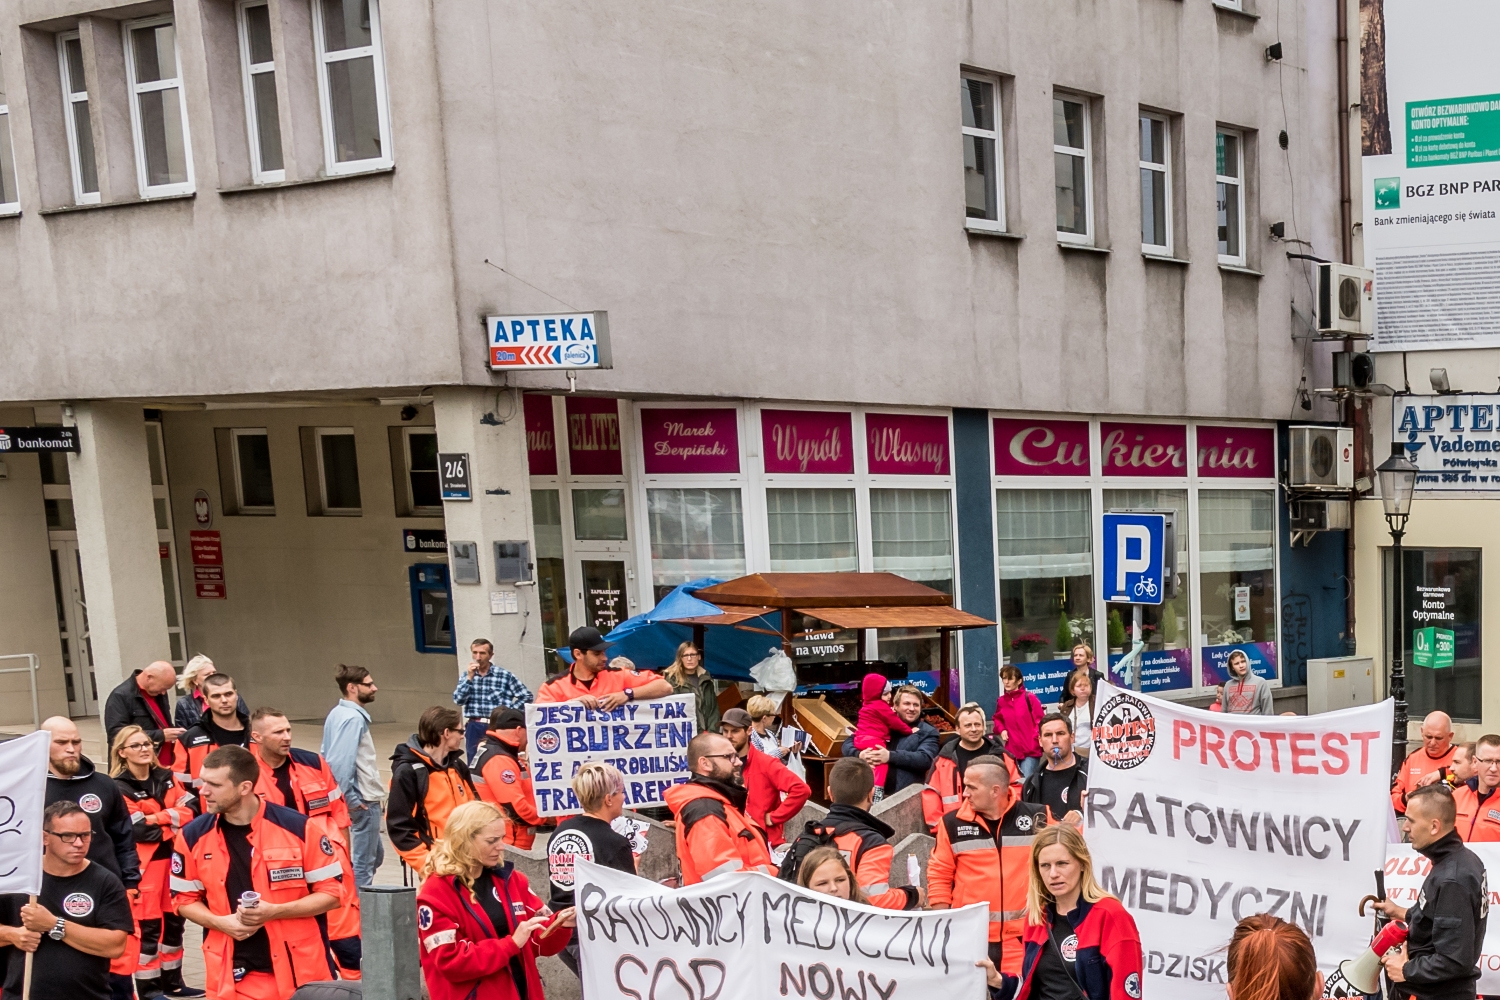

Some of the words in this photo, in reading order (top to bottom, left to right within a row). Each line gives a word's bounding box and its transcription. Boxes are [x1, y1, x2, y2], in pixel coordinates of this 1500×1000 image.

[1411, 105, 1436, 118] OTWÓRZ
[1437, 101, 1489, 116] BEZWARUNKOWO
[1411, 118, 1431, 130] KONTO
[1431, 115, 1469, 129] OPTYMALNE:
[1439, 181, 1469, 195] BNP
[1374, 216, 1394, 226] Bank
[1395, 213, 1453, 224] zmieniającego
[1454, 212, 1467, 222] się
[1468, 210, 1496, 220] świata
[494, 318, 594, 343] APTEKA
[496, 351, 516, 361] 20m
[570, 413, 619, 450] ELITE
[663, 421, 716, 437] Marek
[17, 437, 73, 448] bankomat
[772, 423, 843, 473] Wyrób
[871, 427, 945, 473] Własny
[1009, 426, 1259, 469] Cukiernia
[445, 460, 464, 478] 2/6
[1441, 473, 1459, 483] 365
[1461, 473, 1477, 482] dni
[419, 539, 448, 549] bankom
[1116, 524, 1151, 591] P
[1422, 600, 1445, 609] Konto
[1413, 610, 1455, 621] Optymalne
[796, 646, 809, 656] na
[812, 644, 845, 656] wynos
[1416, 632, 1424, 651] 0
[1151, 657, 1177, 665] doskonale
[1140, 666, 1181, 676] więtomarcińskie
[649, 702, 688, 720] TAK
[1091, 717, 1156, 741] PROTEST
[1172, 718, 1381, 776] PROTEST
[534, 758, 563, 782] ŻE
[571, 755, 592, 778] A
[1087, 787, 1362, 862] RATOWNICY
[1101, 865, 1328, 936] MEDYCZNI
[580, 881, 752, 948] RATOWNICY
[762, 890, 952, 975] MEDYCZNI
[1141, 950, 1226, 985] DZISK
